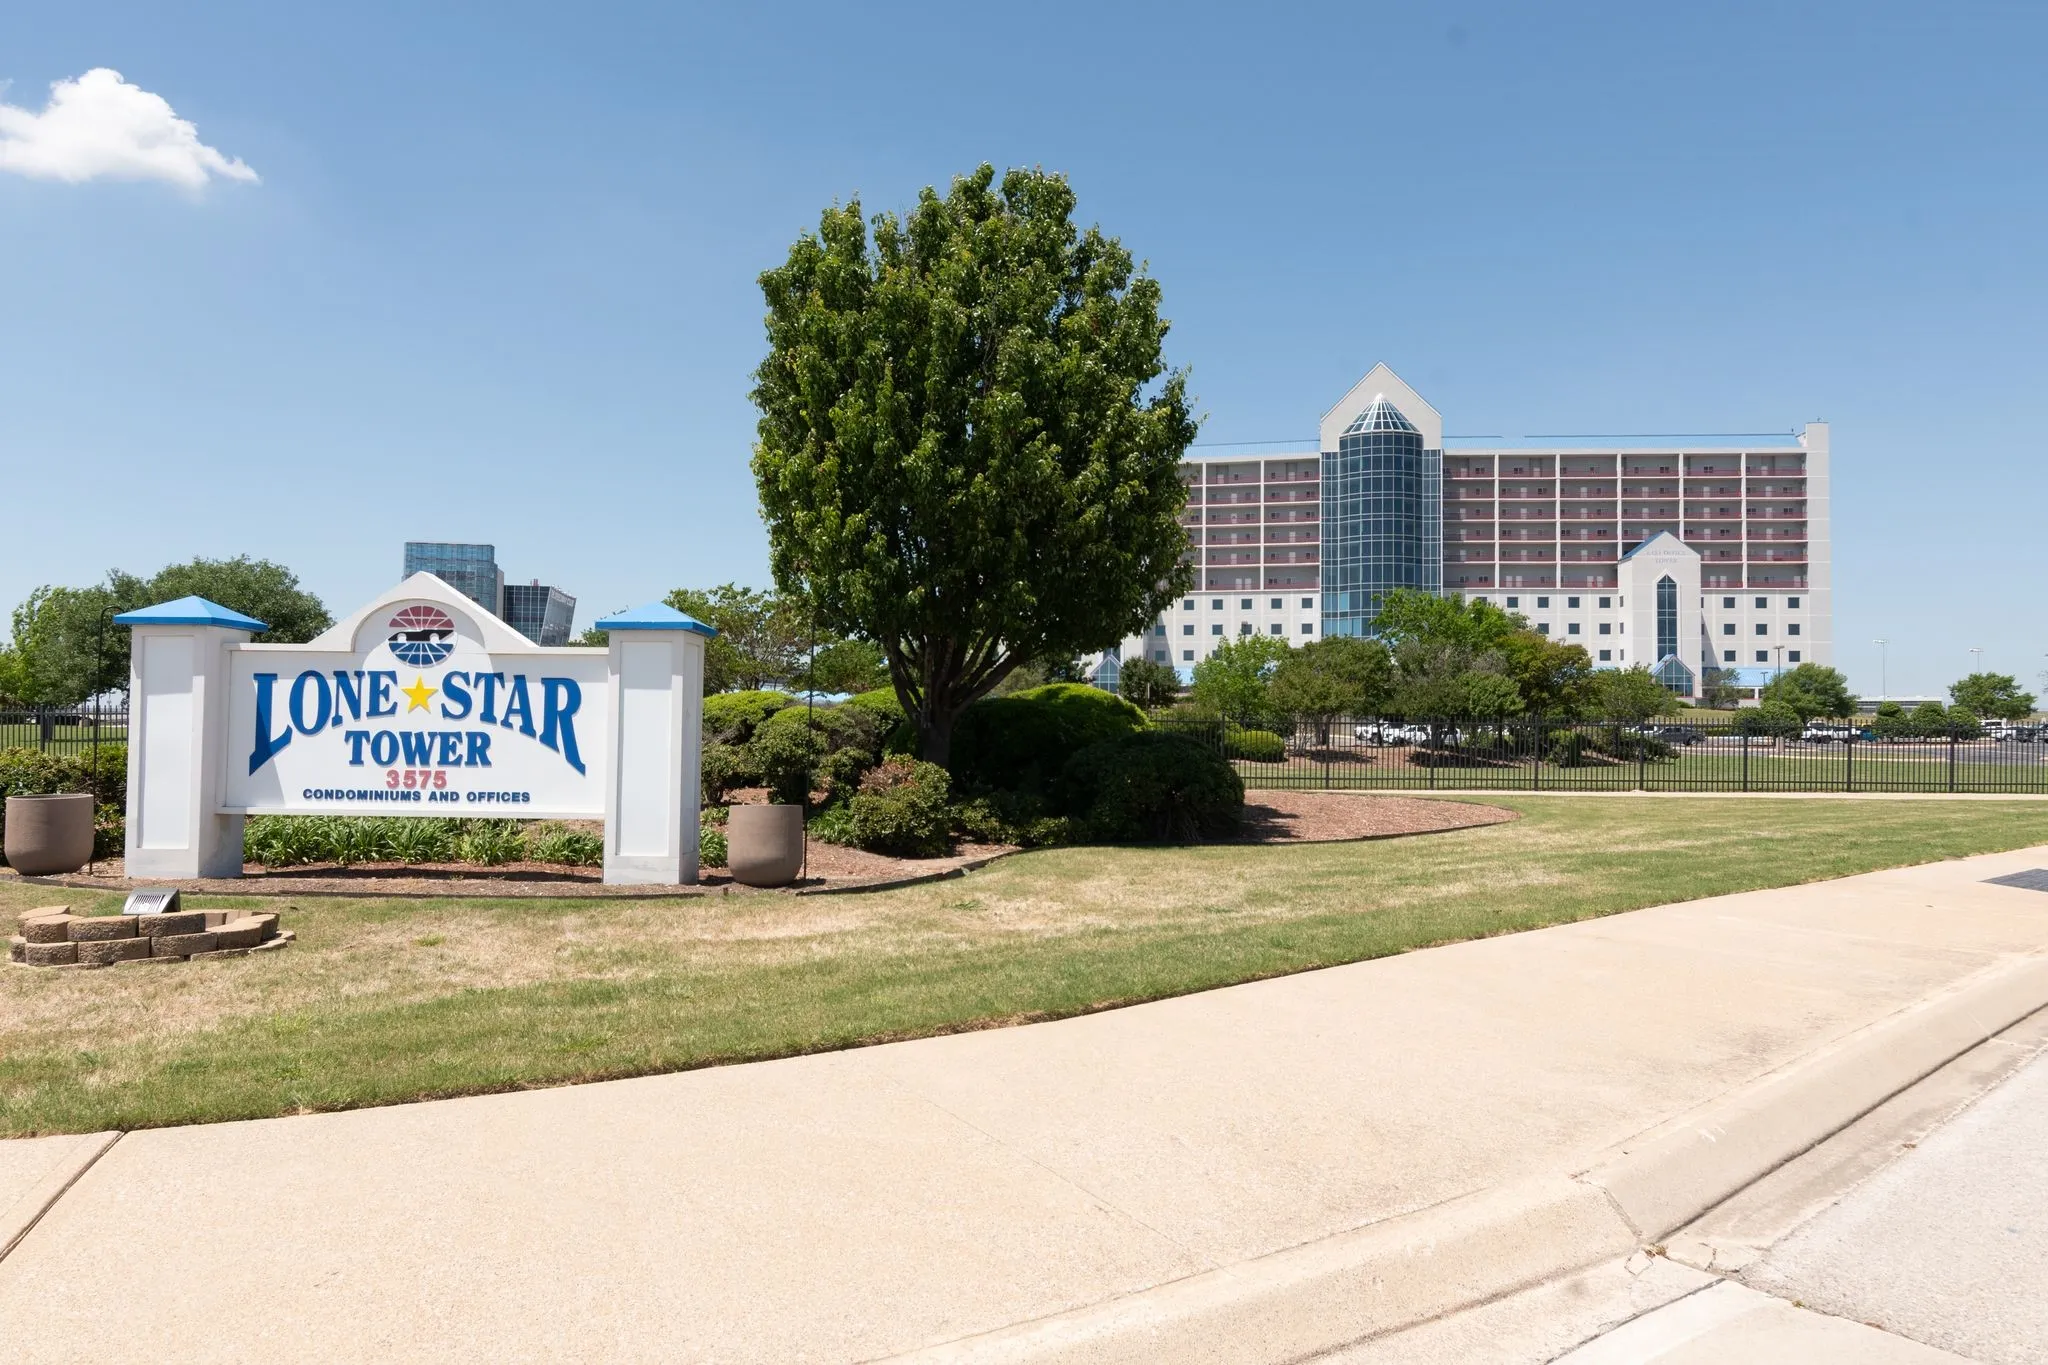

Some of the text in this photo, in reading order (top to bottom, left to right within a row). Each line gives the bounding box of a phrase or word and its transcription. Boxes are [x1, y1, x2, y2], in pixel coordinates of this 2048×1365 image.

[249, 670, 586, 776] LONE STAR
[345, 730, 492, 766] TOWER
[386, 769, 447, 789] 3575
[303, 789, 530, 803] CONDOMINIUMS AND OFFICES
